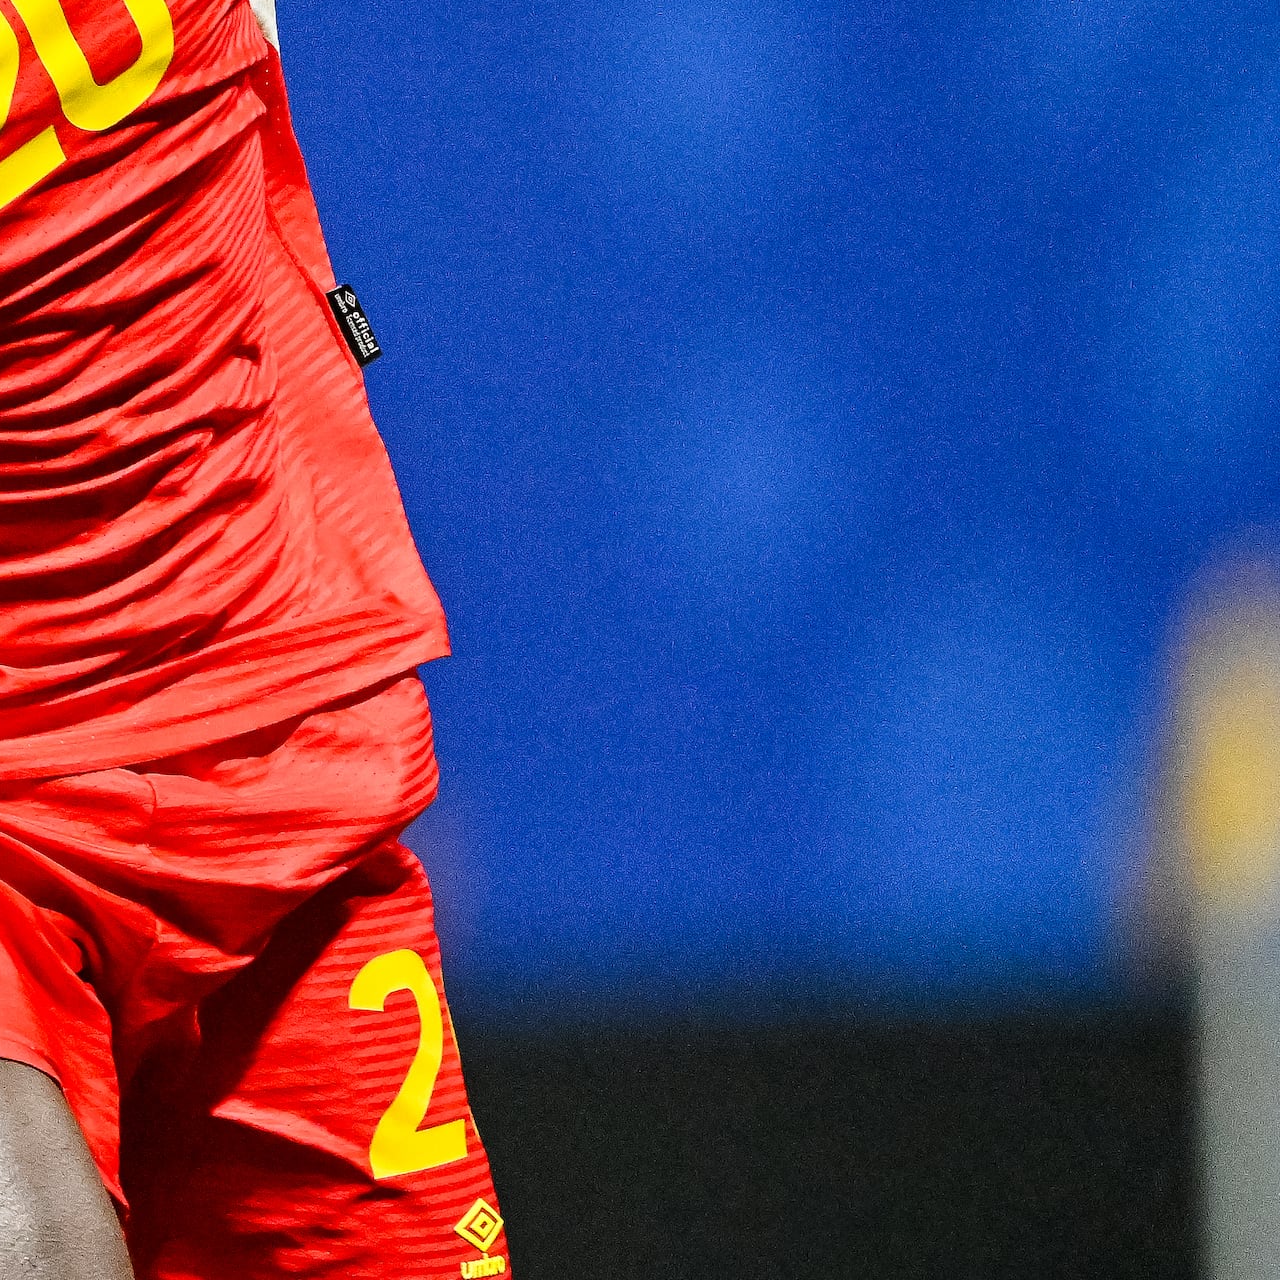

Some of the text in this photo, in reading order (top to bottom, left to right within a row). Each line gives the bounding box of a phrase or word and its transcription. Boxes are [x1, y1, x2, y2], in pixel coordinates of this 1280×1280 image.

[353, 312, 379, 353] official
[348, 948, 468, 1180] 2
[459, 1252, 507, 1280] umbro
